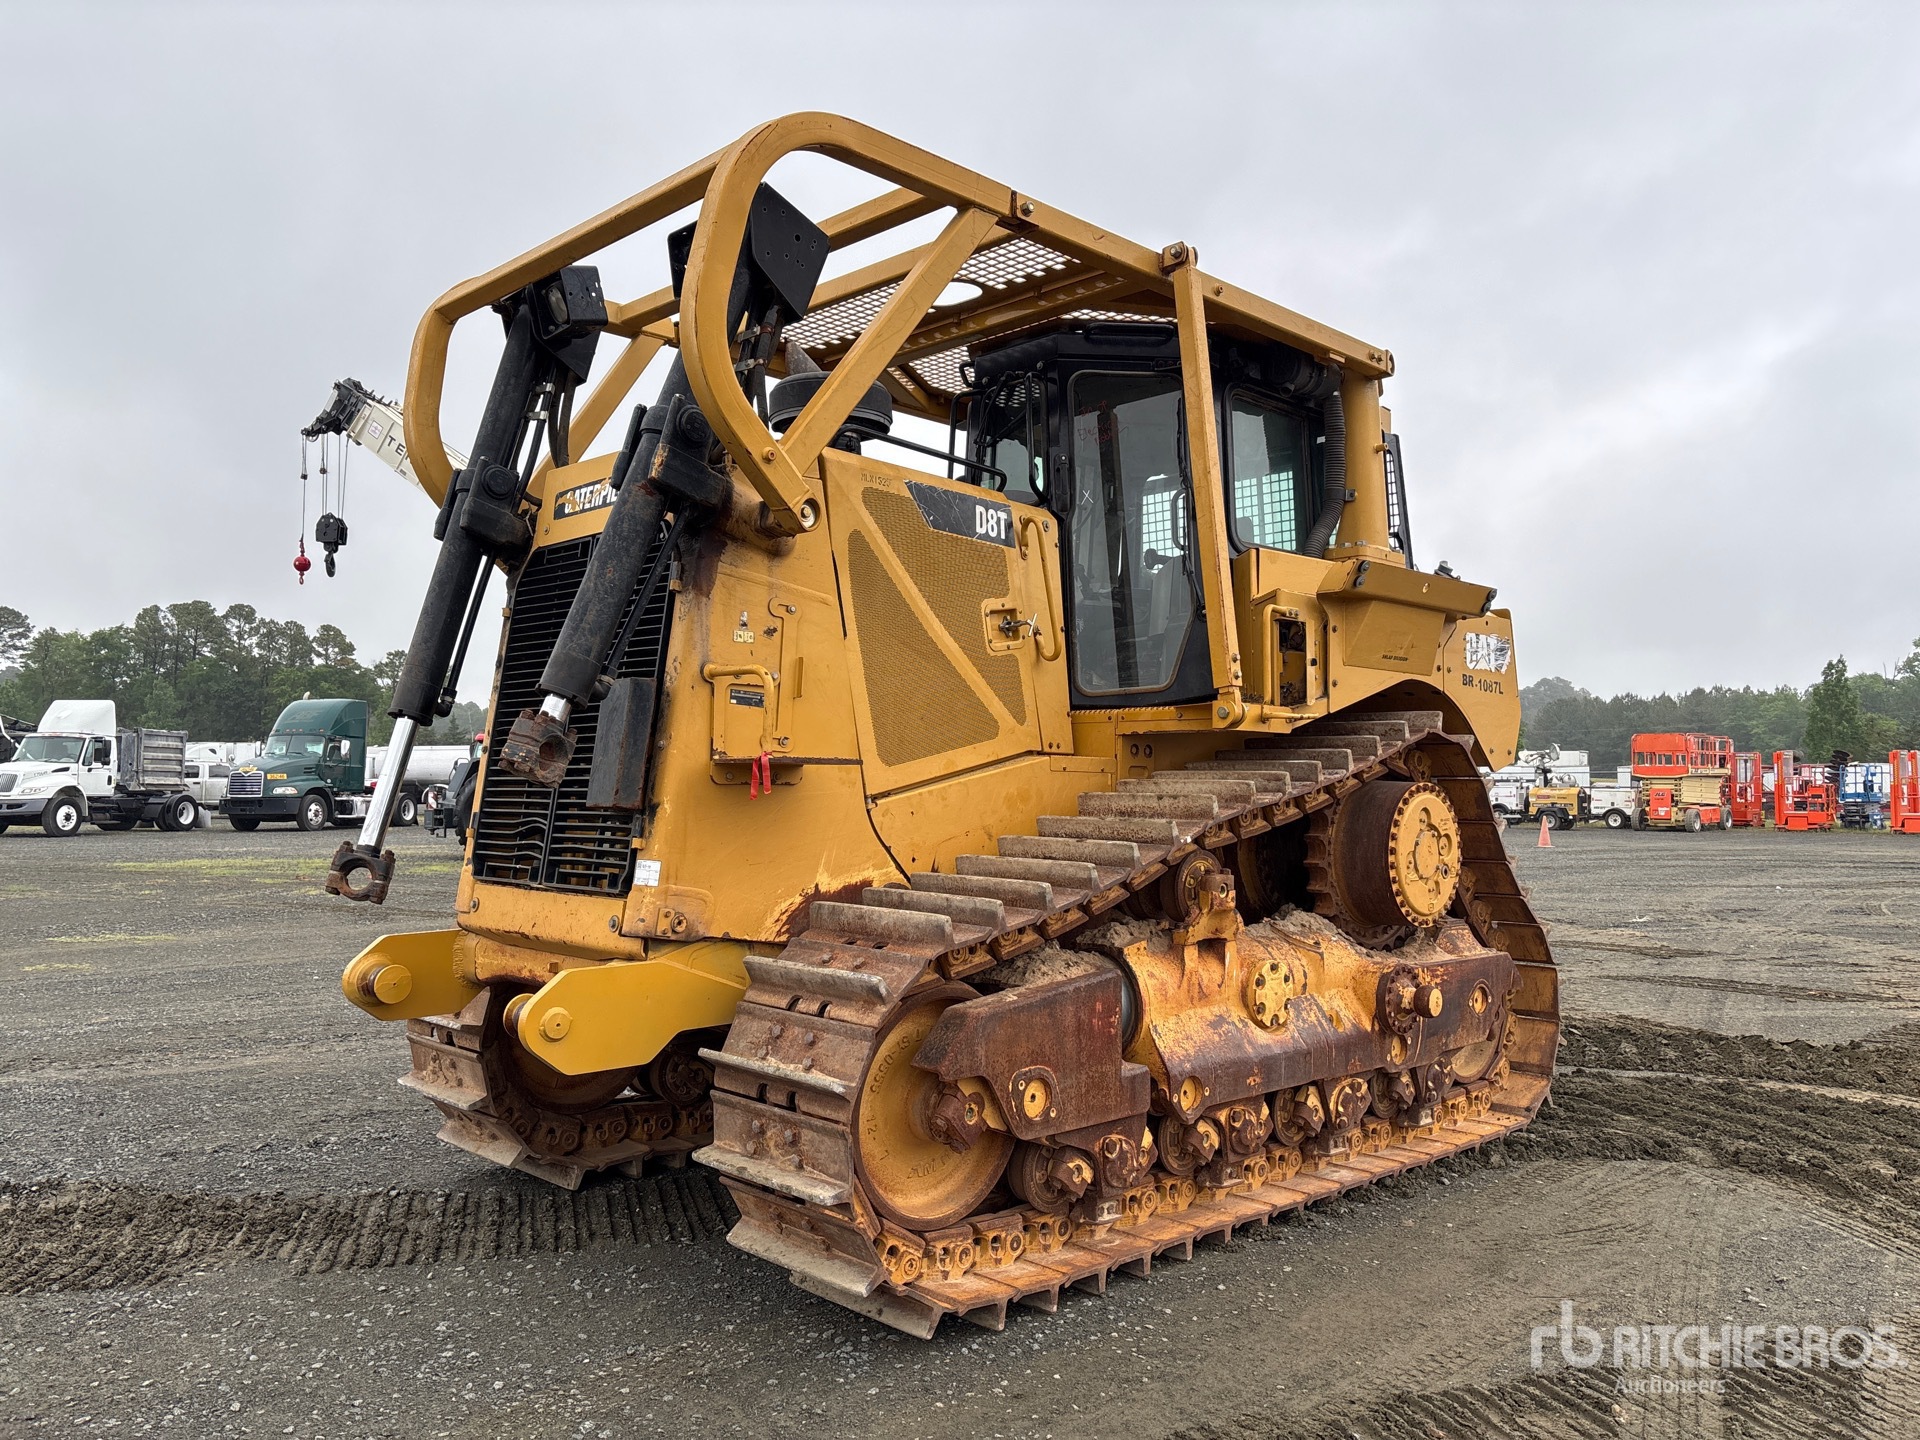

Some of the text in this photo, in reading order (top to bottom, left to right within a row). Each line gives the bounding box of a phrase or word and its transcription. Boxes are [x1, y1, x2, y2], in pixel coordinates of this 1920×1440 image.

[387, 434, 409, 461] TE
[564, 480, 619, 514] CATERPIL
[975, 504, 1008, 540] D8T
